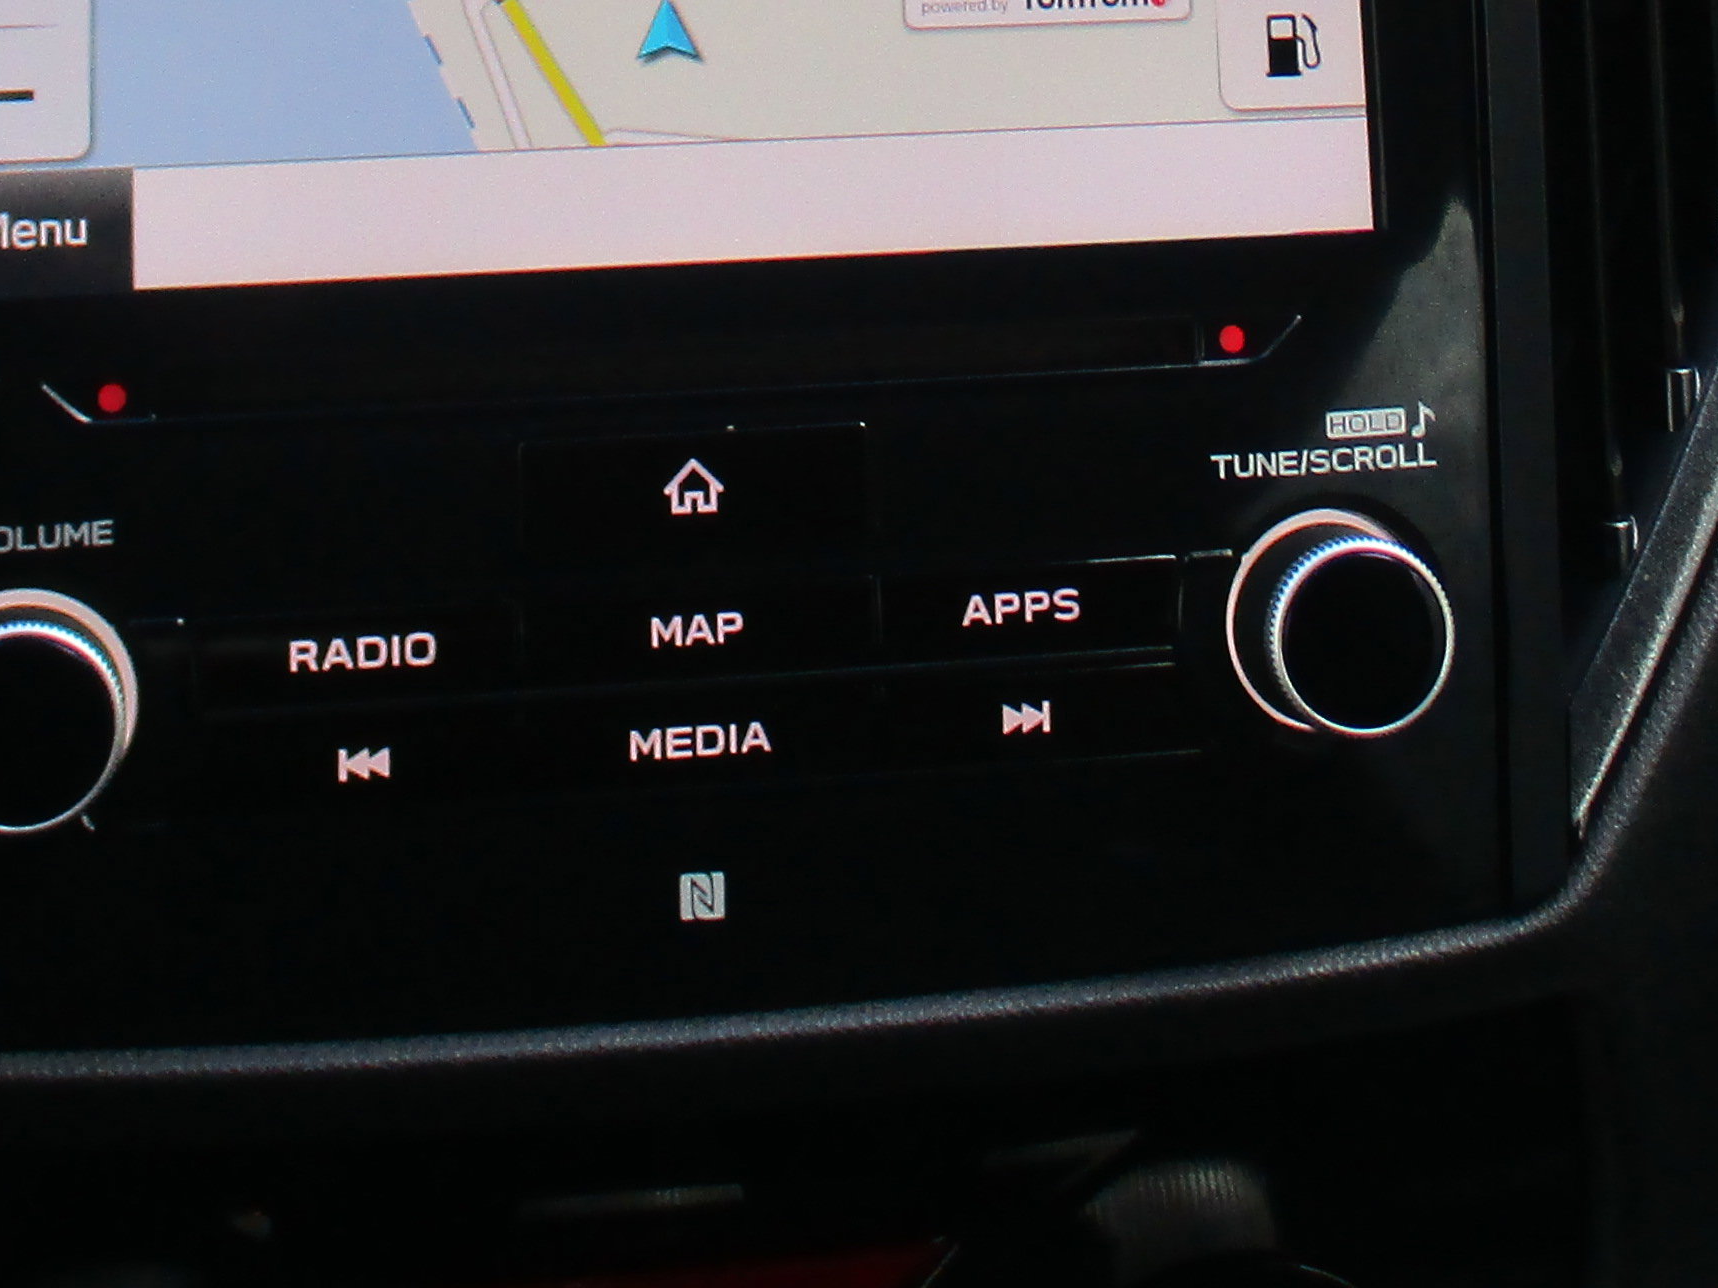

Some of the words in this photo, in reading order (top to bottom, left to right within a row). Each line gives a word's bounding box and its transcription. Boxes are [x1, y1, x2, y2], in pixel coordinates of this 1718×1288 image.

[920, 0, 990, 18] powered
[1328, 411, 1403, 436] HOLD
[1209, 442, 1439, 481] TUNE/SCROLL
[961, 587, 1081, 628] APPS
[649, 610, 745, 649] MAP
[288, 631, 437, 674] RADIO
[628, 720, 772, 762] MEDIA
